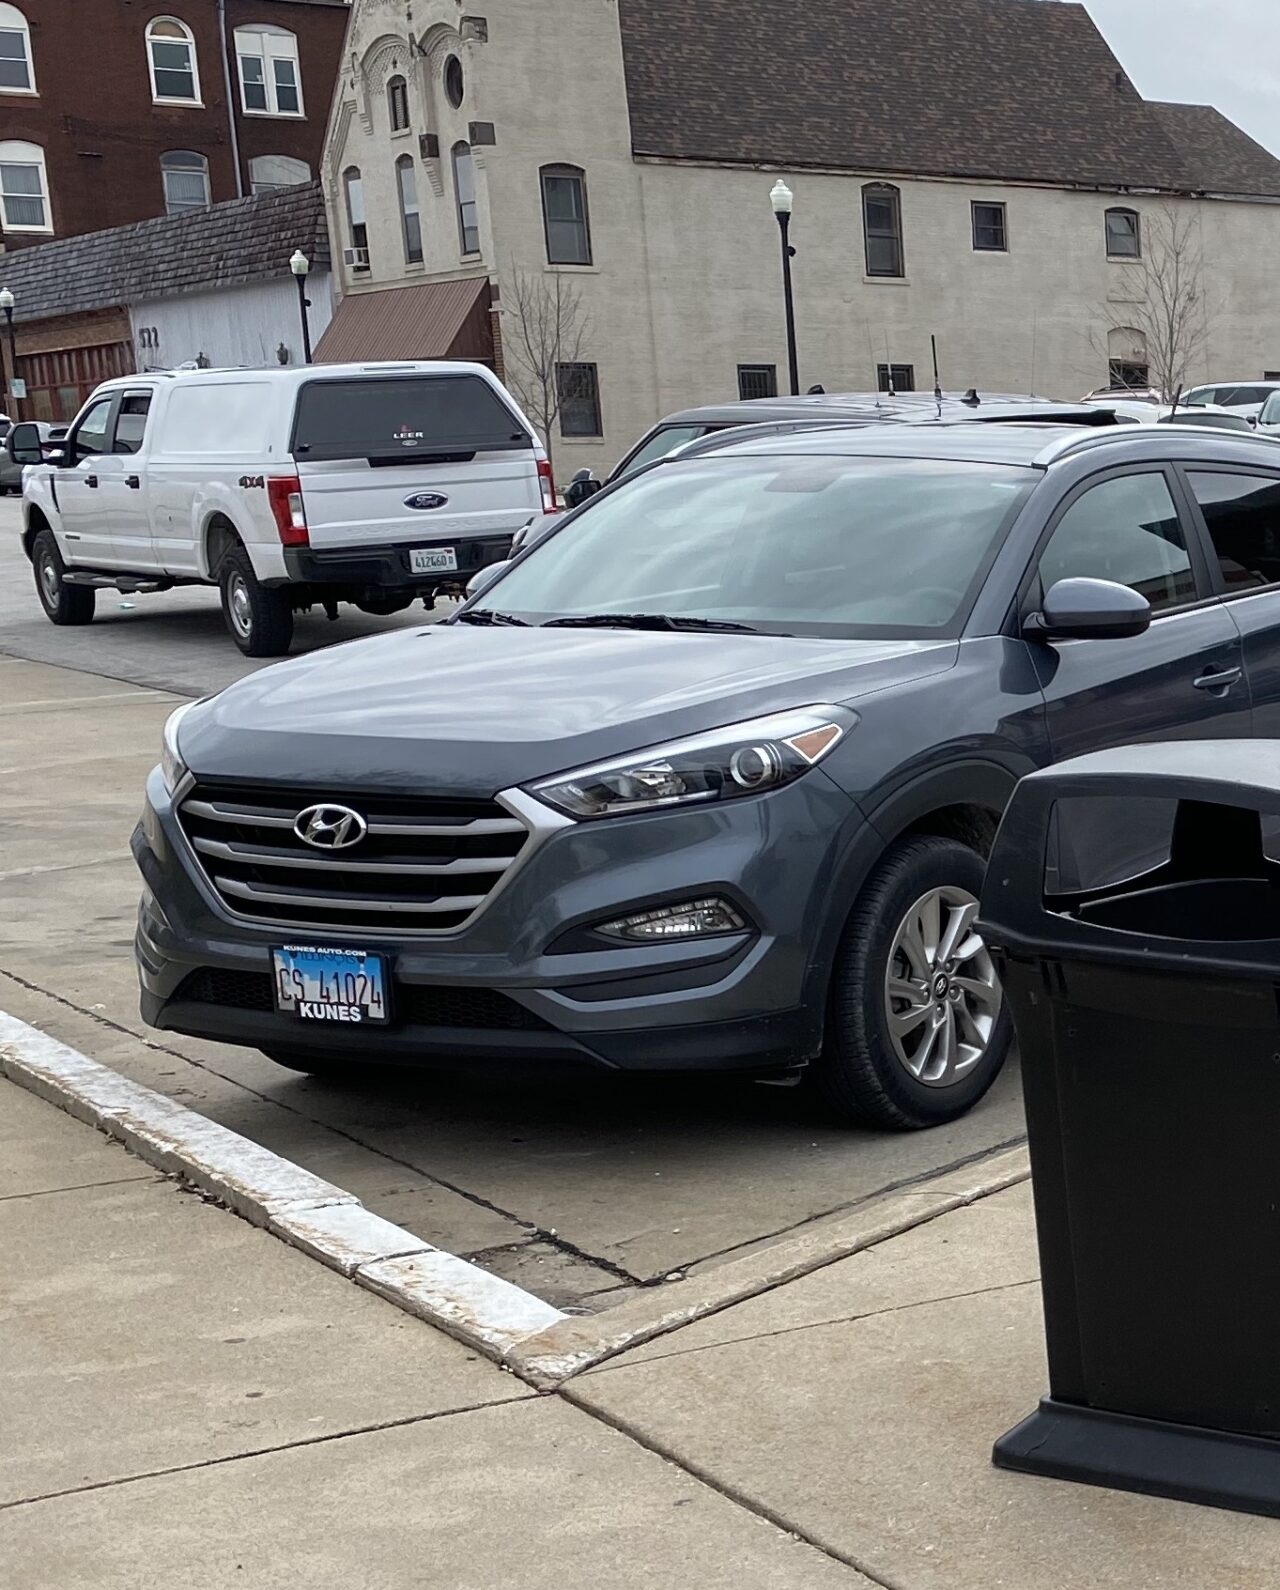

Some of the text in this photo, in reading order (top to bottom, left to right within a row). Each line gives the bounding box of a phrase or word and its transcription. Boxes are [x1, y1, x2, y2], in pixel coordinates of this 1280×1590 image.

[393, 431, 424, 439] LEER
[414, 495, 439, 507] Ford
[283, 945, 368, 957] KUNES AUTO.COM
[279, 967, 382, 1009] CS 41024
[299, 1001, 362, 1022] KUNES
